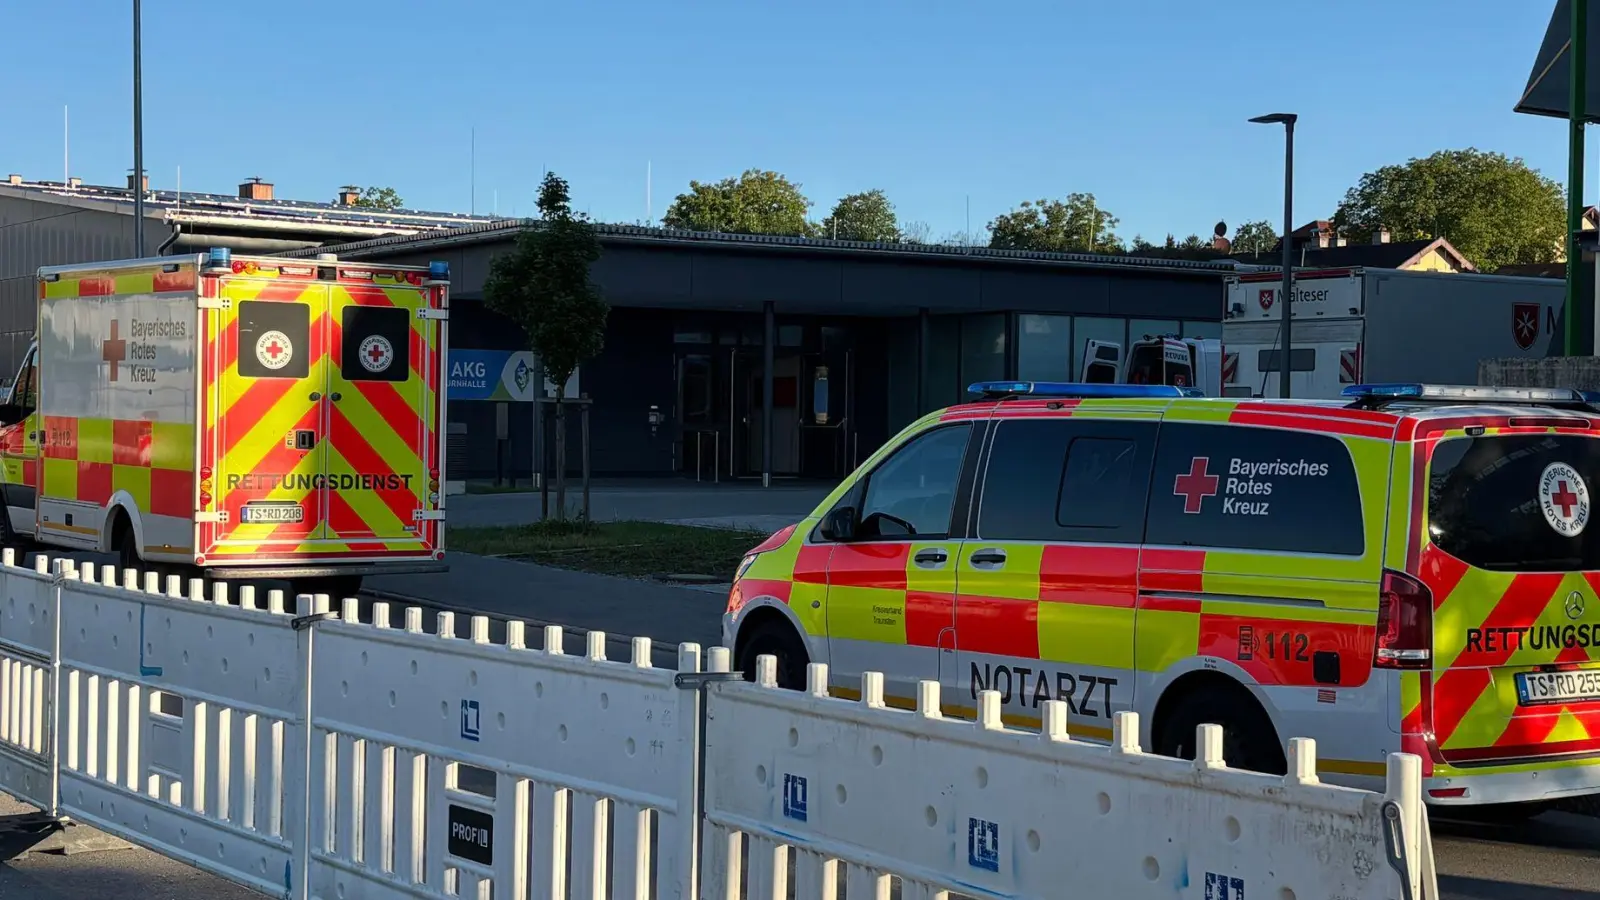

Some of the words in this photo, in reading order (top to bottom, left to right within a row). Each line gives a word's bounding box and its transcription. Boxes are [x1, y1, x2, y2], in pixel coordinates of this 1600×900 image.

[130, 317, 186, 341] Bayerisches
[130, 342, 157, 360] Rotes
[130, 364, 156, 382] Kreuz
[451, 361, 486, 378] AKG
[1229, 458, 1329, 478] Bayerisches
[227, 473, 413, 490] RETTUNGSDIENST
[1225, 477, 1273, 495] Rotes
[1542, 467, 1585, 496] BAYERISCHES
[1222, 497, 1269, 515] Kreuz
[1544, 500, 1567, 531] ROTES
[1569, 501, 1587, 532] KREUZ
[1265, 632, 1309, 662] 112
[970, 661, 1118, 718] NOTARZT
